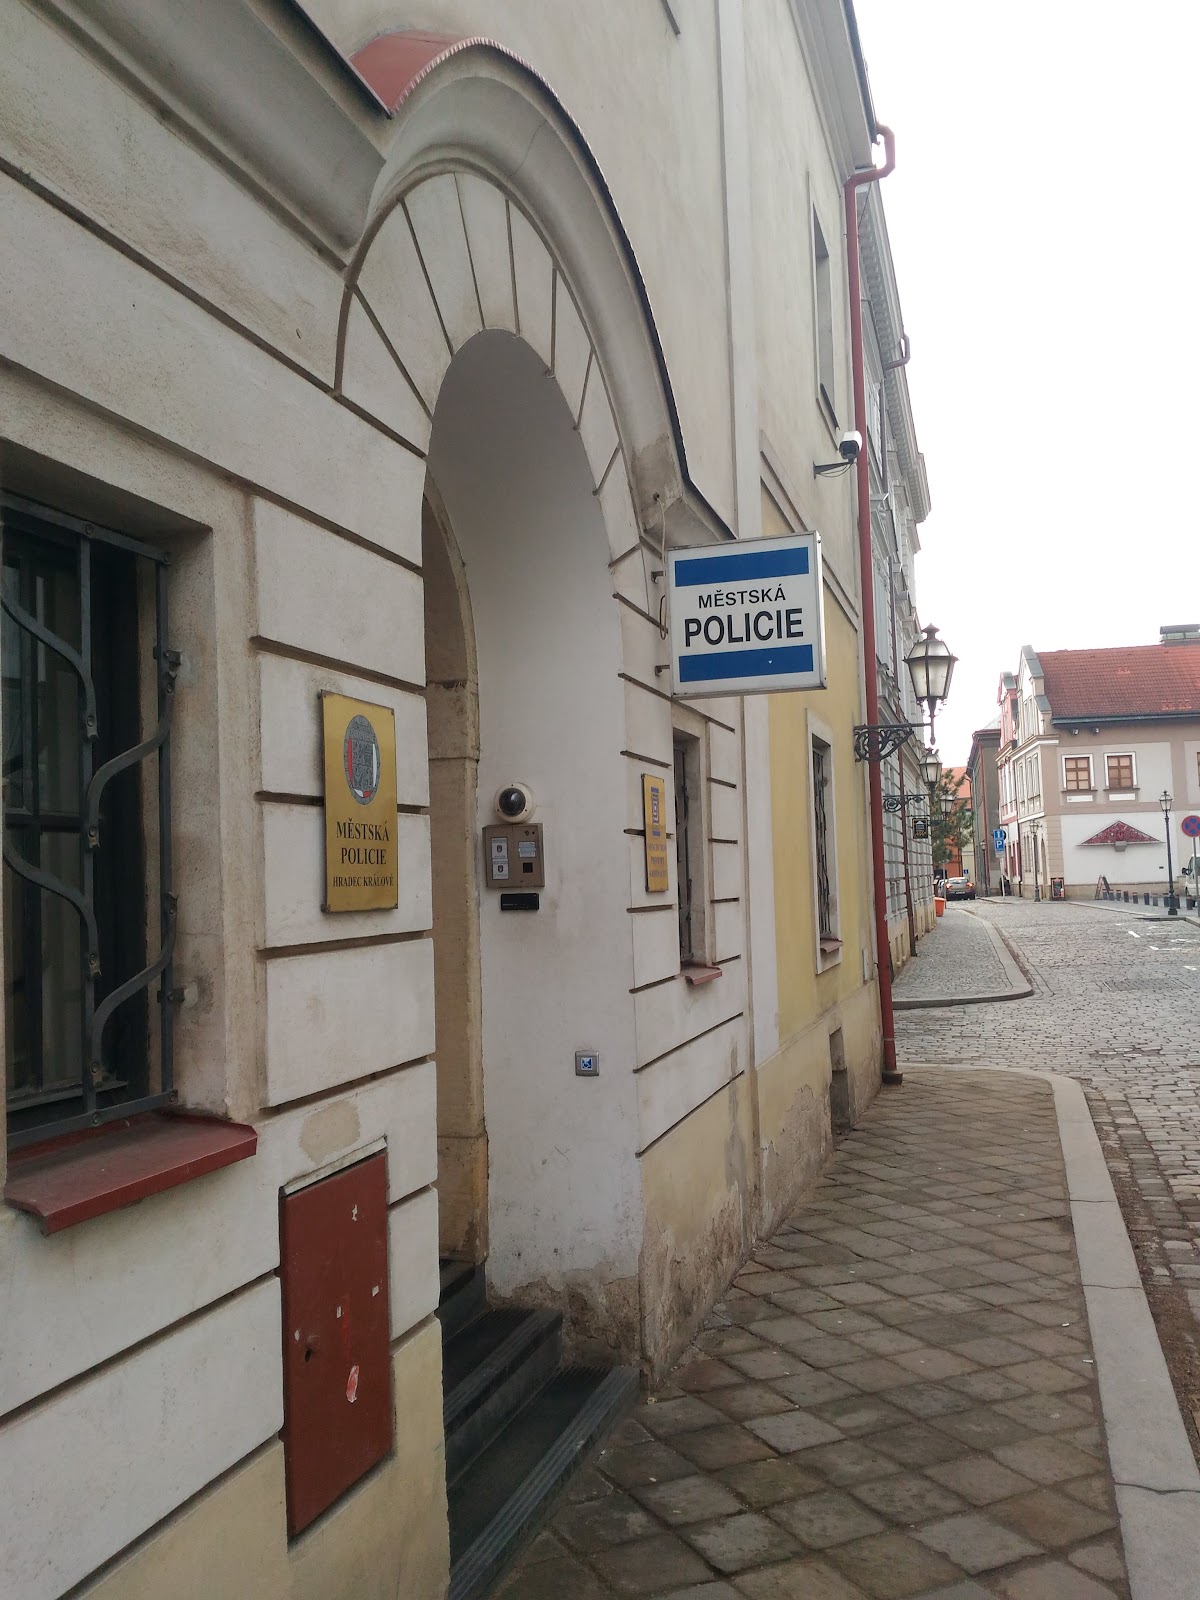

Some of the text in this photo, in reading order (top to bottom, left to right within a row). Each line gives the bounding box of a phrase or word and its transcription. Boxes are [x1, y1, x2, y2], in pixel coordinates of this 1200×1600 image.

[698, 583, 786, 609] MĚSTSKÁ
[684, 608, 804, 648] POLICIE
[336, 817, 390, 842] MĚSTSKÁ
[996, 840, 1003, 849] P
[341, 847, 387, 865] POLICIE
[333, 873, 394, 887] HRADEC KRÁLOVÉ
